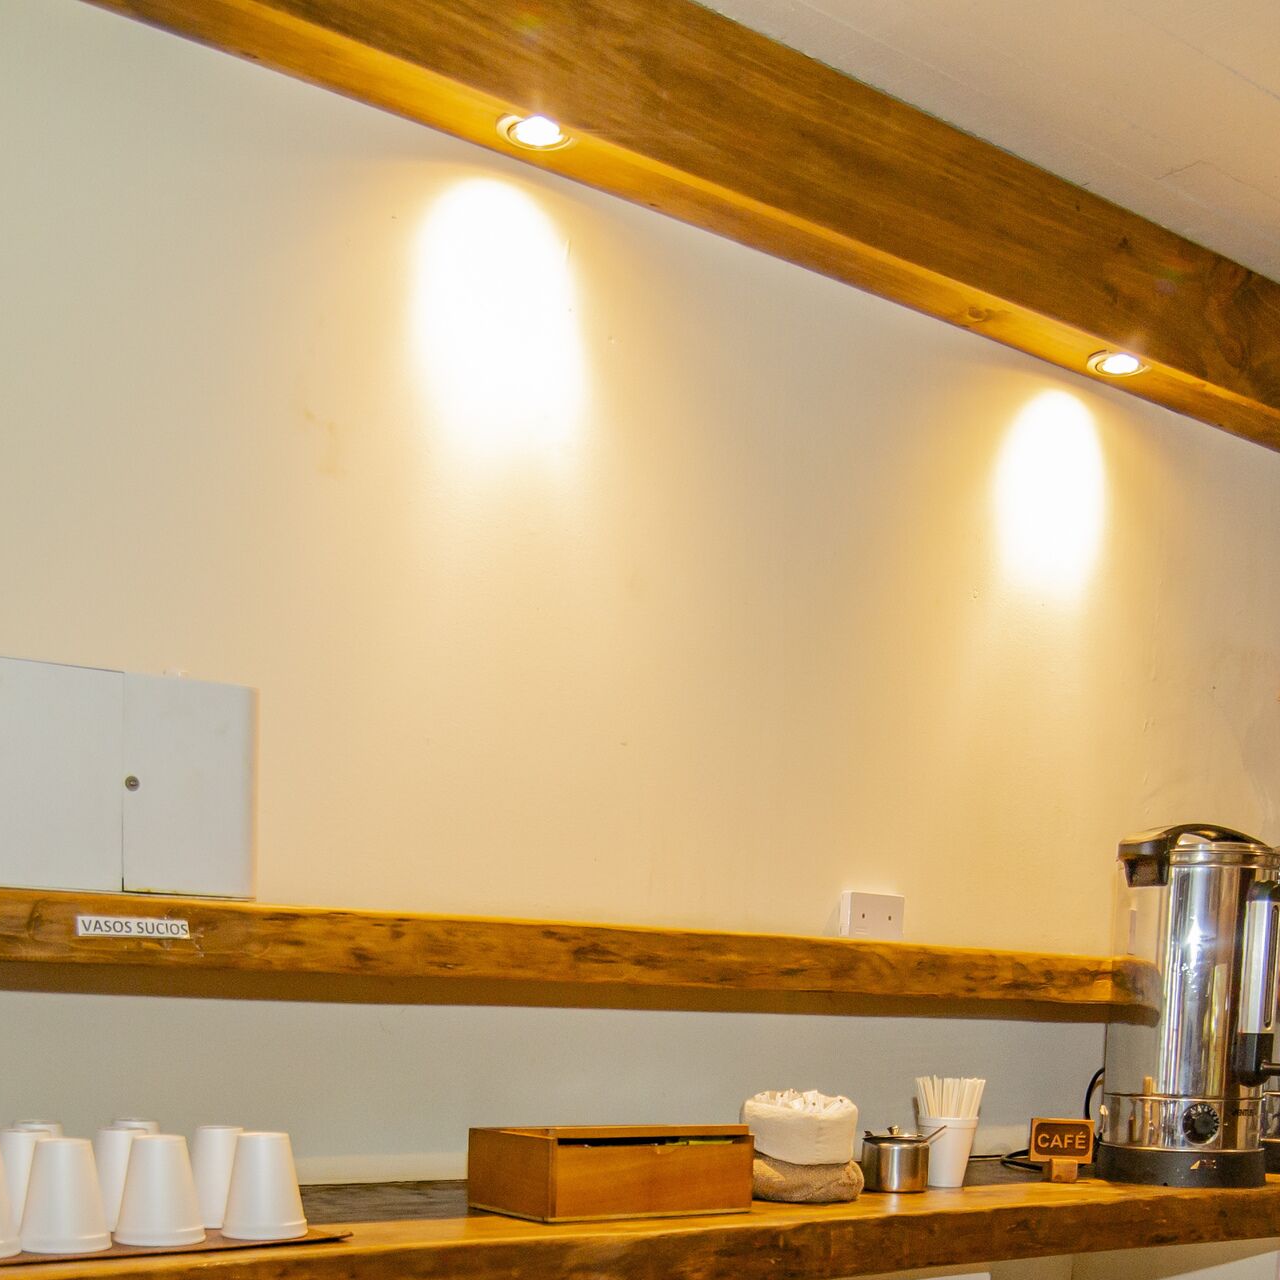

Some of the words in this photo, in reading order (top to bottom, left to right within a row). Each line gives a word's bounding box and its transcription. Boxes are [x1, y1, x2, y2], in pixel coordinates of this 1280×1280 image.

[81, 919, 133, 934] VASOS
[136, 921, 188, 936] SUCIOS
[1037, 1131, 1087, 1149] CAFÉ
